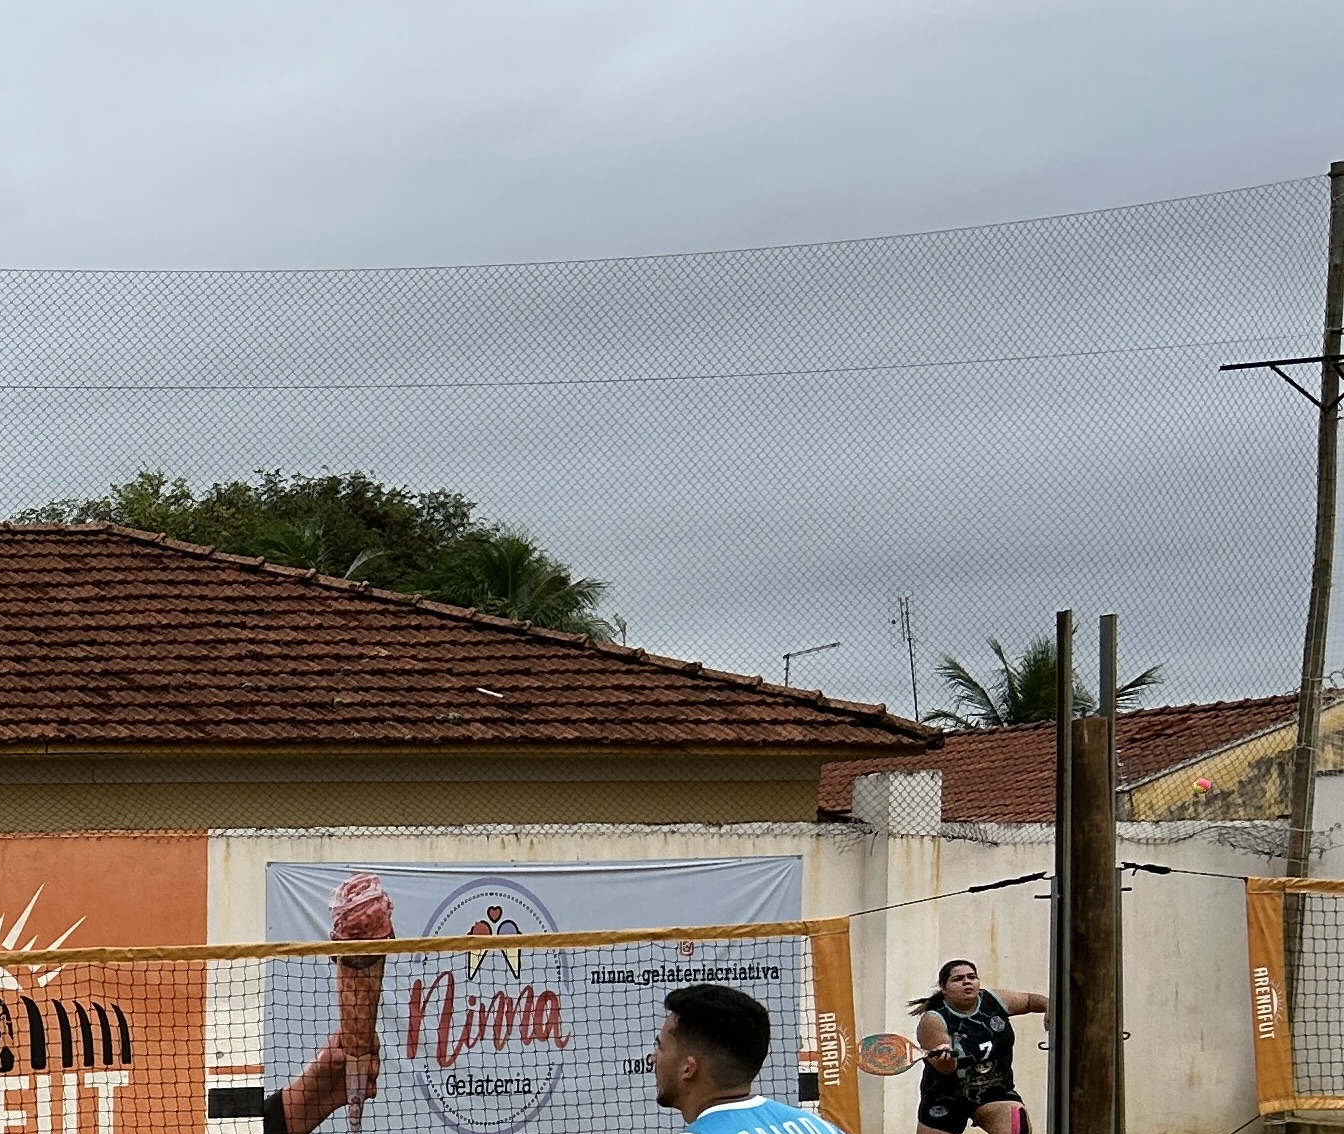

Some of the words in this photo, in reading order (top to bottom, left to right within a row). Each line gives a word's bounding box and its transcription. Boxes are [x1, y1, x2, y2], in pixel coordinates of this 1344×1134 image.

[590, 962, 780, 986] ninna_gelateriacriativa
[406, 970, 571, 1068] Ninna
[1252, 966, 1275, 1039] ARENAFUT
[818, 1012, 840, 1086] ARENAFUT
[978, 1040, 993, 1061] 7
[445, 1073, 532, 1097] Gelateria
